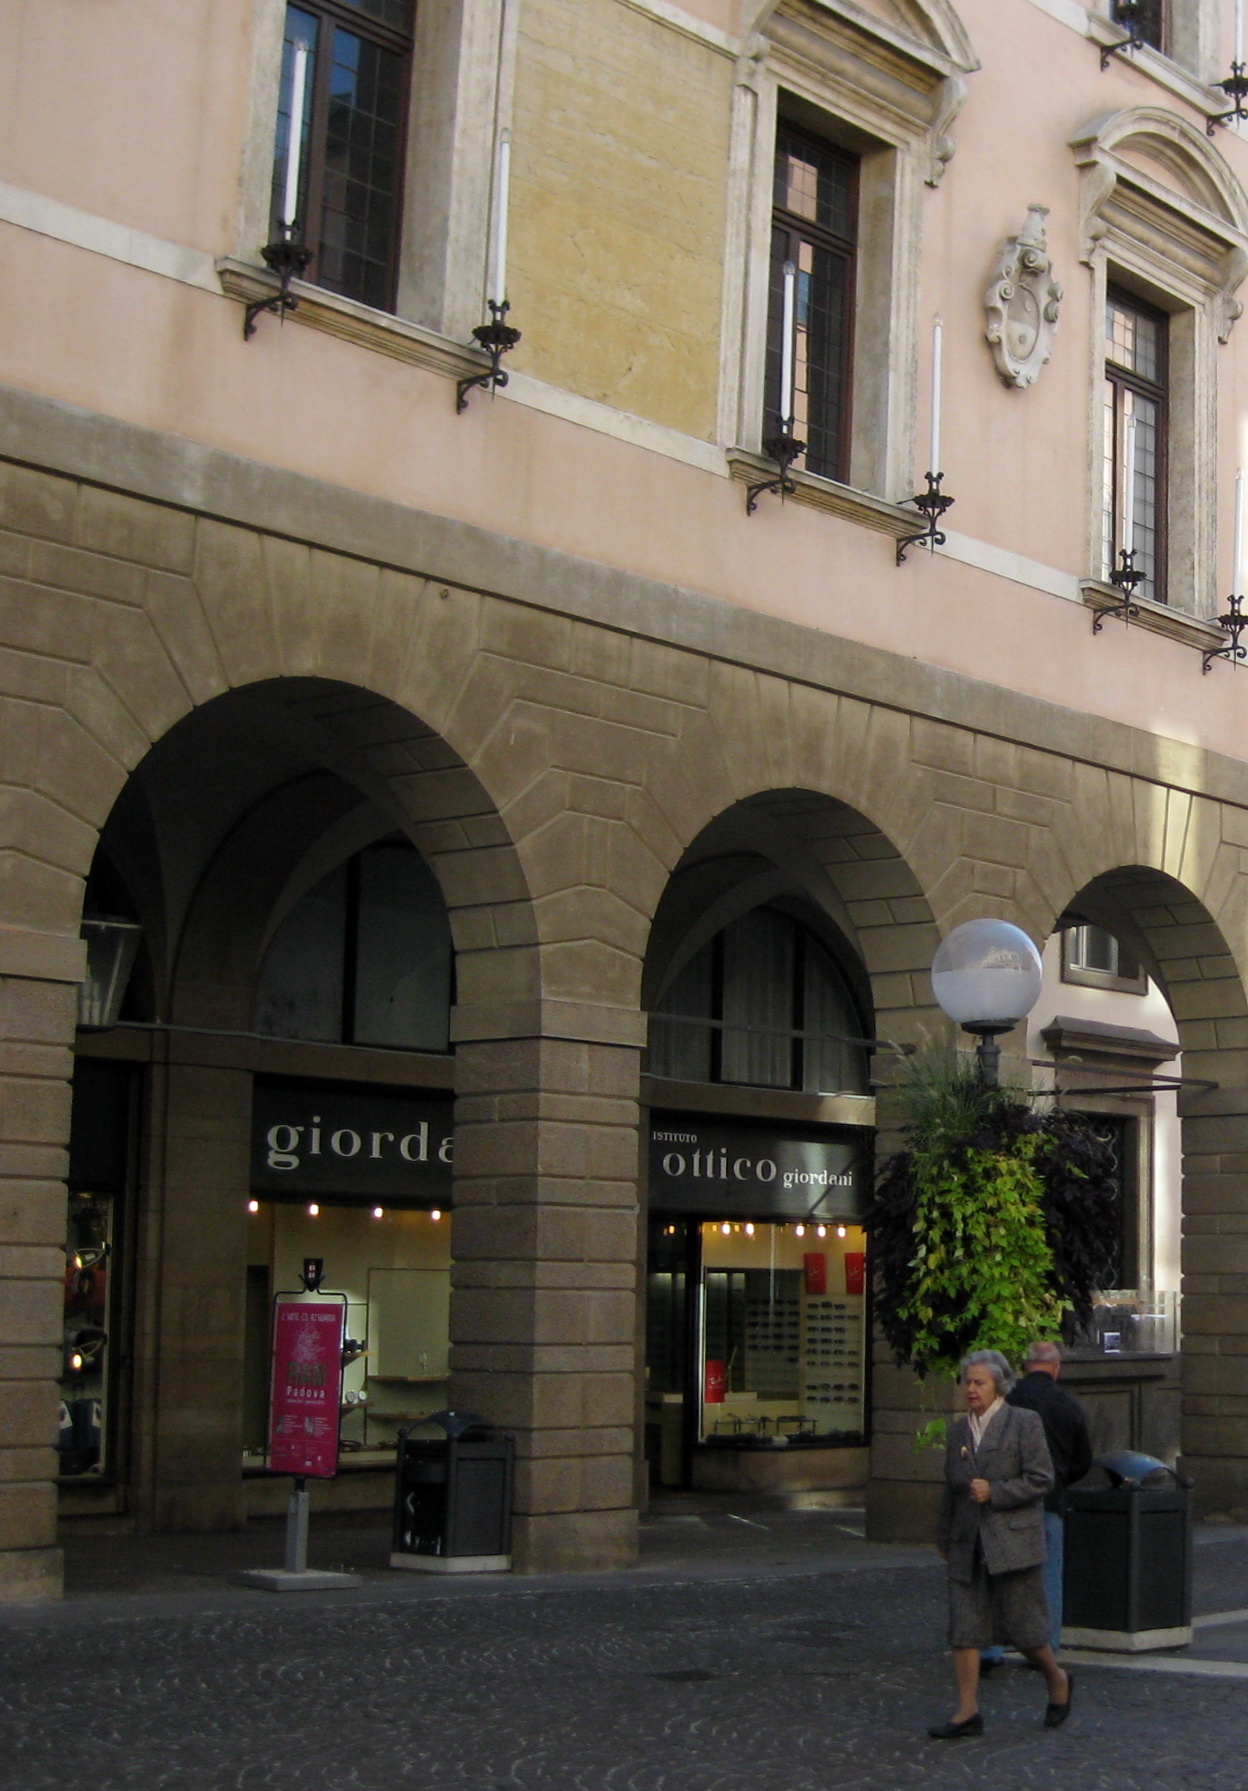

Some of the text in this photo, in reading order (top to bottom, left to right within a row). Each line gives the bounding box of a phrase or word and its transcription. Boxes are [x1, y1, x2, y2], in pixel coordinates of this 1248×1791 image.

[653, 1131, 698, 1145] ISTITUTO
[662, 1147, 853, 1190] ottico giordani
[286, 1386, 325, 1399] Padova
